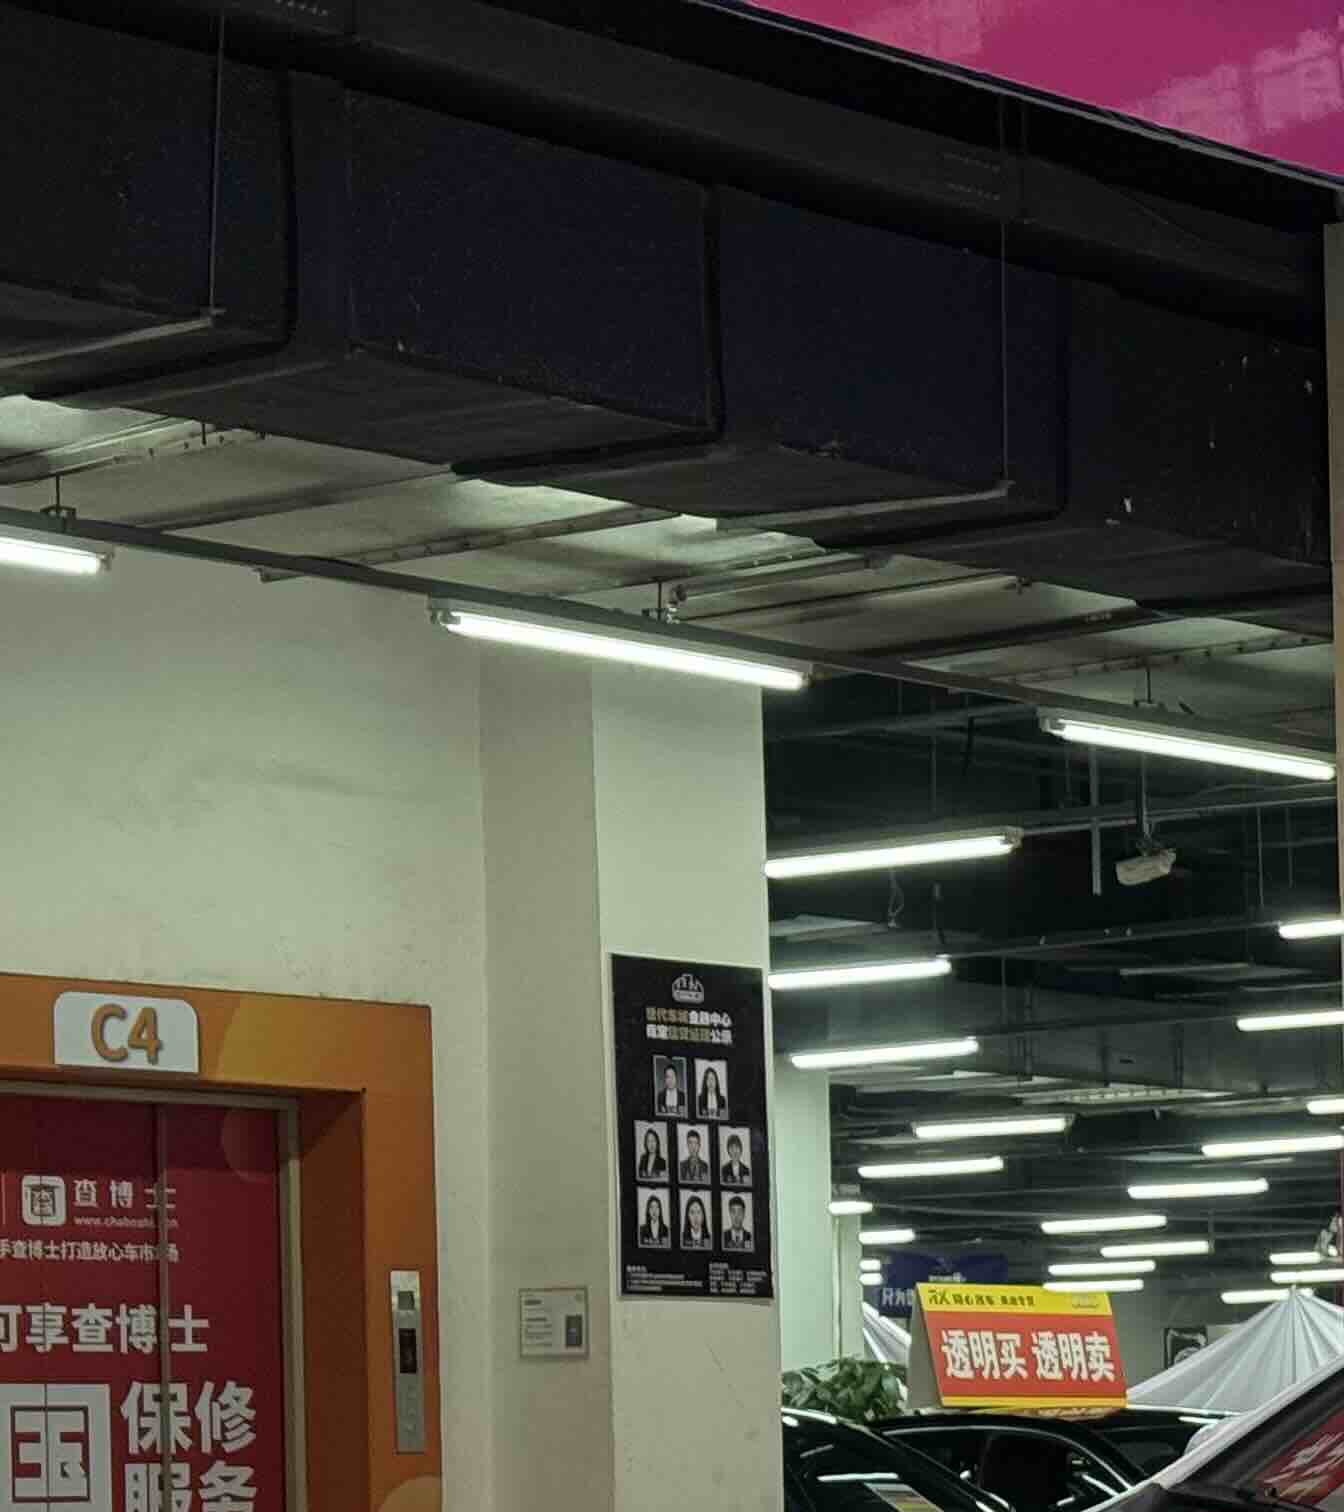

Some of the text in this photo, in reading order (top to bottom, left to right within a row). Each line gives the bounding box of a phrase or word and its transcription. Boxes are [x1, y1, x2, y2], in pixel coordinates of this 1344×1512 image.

[91, 1003, 163, 1066] C4
[73, 1179, 177, 1209] 查博士
[941, 1328, 1115, 1382] 透明买 透明卖
[120, 1381, 257, 1455] 保修
